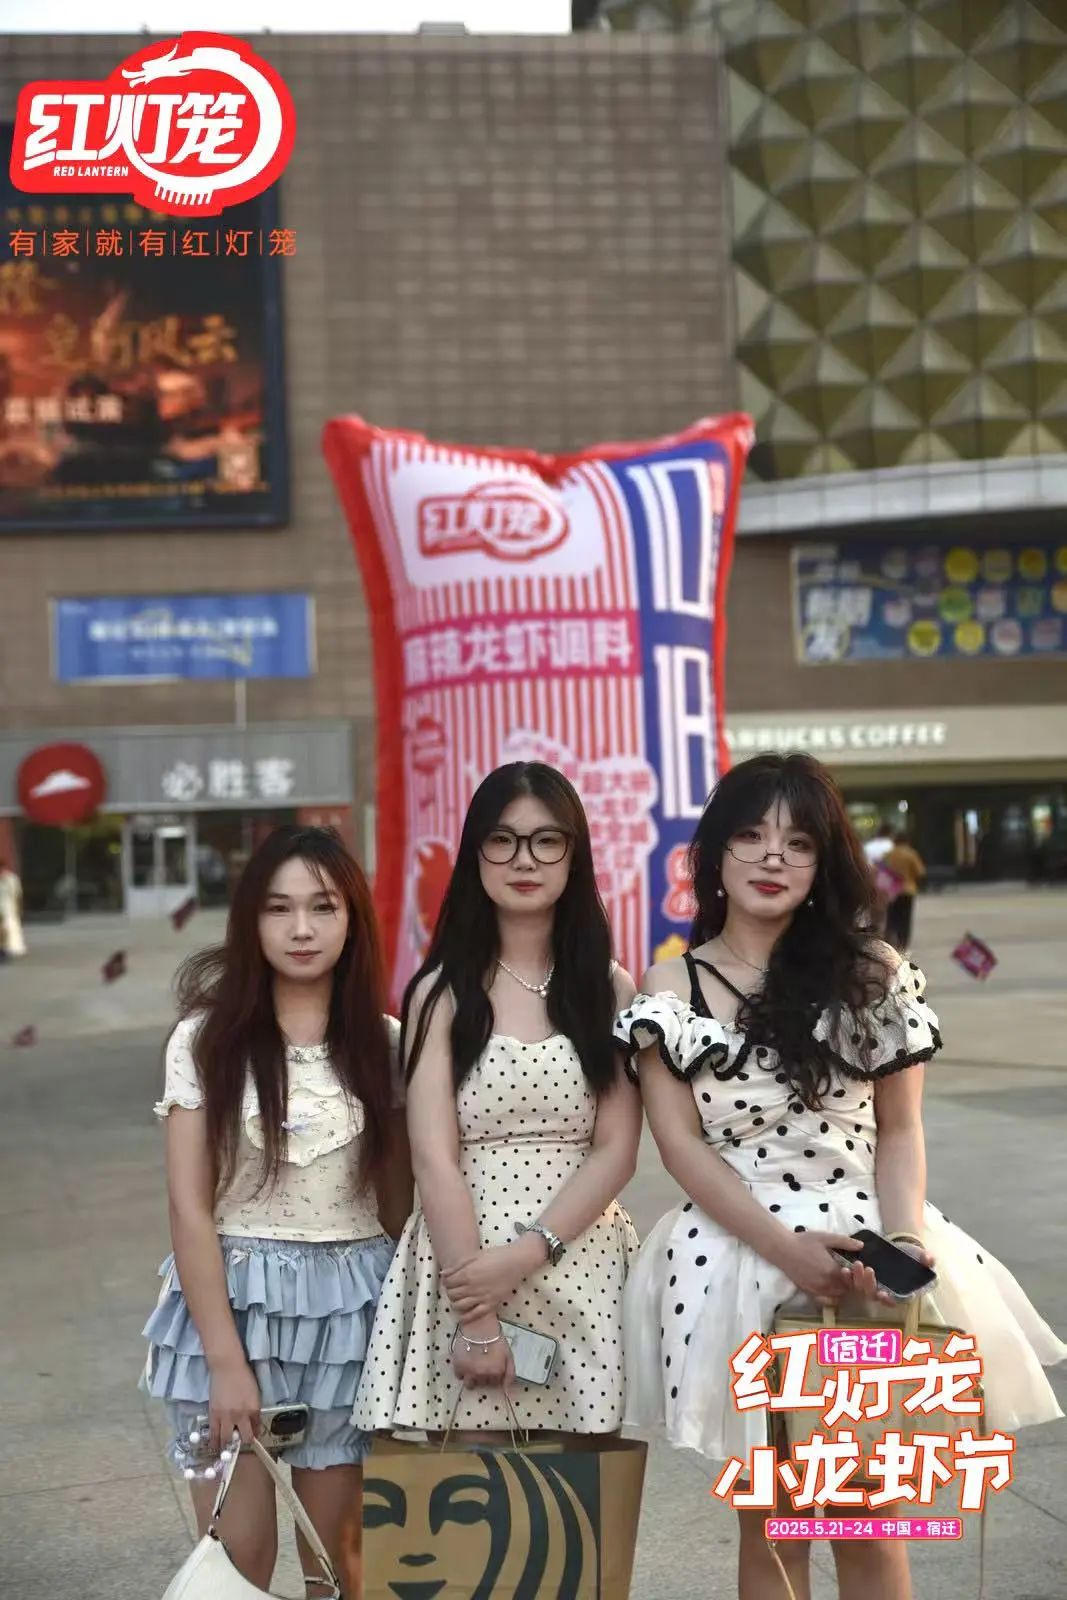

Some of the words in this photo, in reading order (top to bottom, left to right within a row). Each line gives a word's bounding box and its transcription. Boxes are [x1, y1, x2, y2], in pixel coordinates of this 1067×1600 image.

[849, 722, 947, 748] COFFEE
[161, 757, 296, 800] 必胜客
